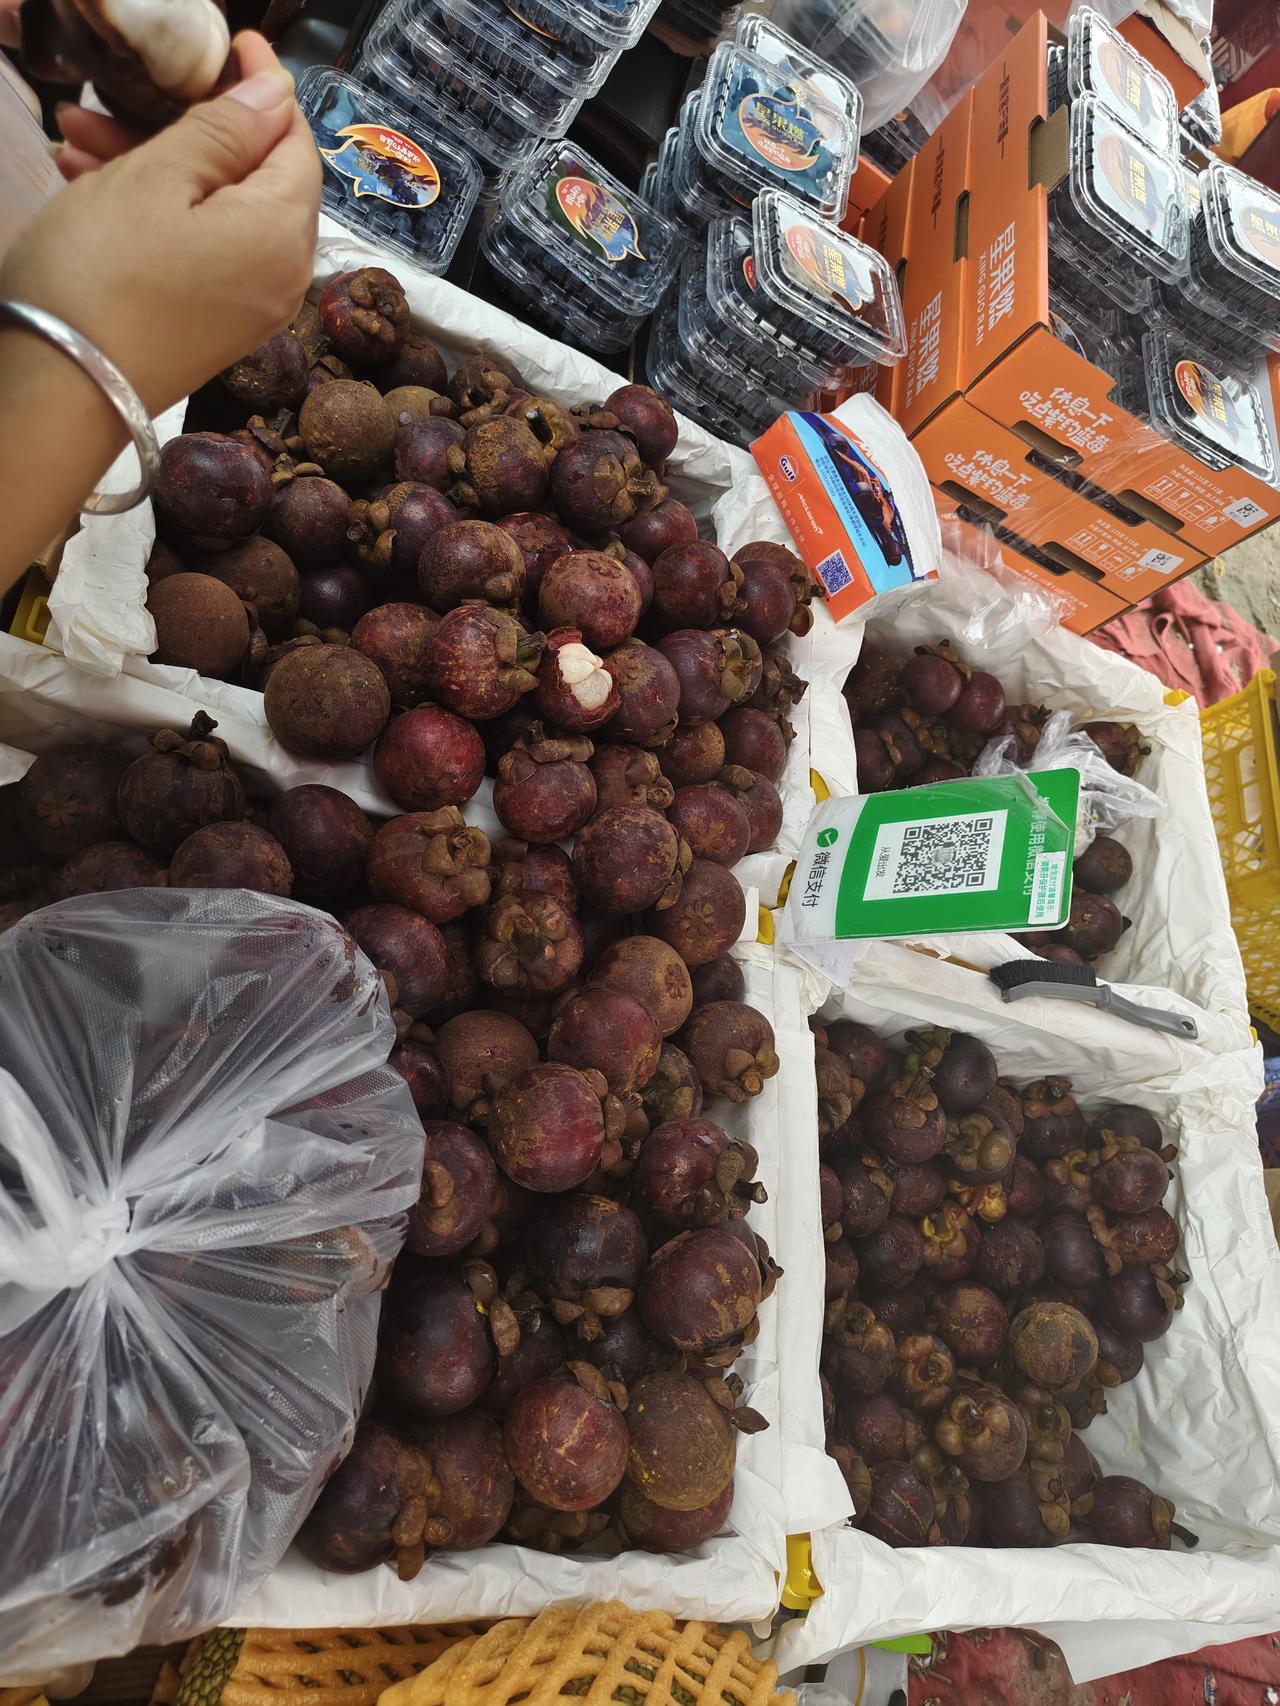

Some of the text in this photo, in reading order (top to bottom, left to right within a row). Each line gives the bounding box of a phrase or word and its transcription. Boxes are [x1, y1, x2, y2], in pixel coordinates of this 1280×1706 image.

[987, 220, 1016, 331] 星果燃
[976, 252, 987, 347] XING GUO RAN
[1049, 387, 1115, 428] 休息一下
[780, 457, 797, 481] Gulf
[971, 449, 1033, 487] 休息一下
[796, 492, 822, 535] McLaren
[801, 851, 832, 908] 微信支付
